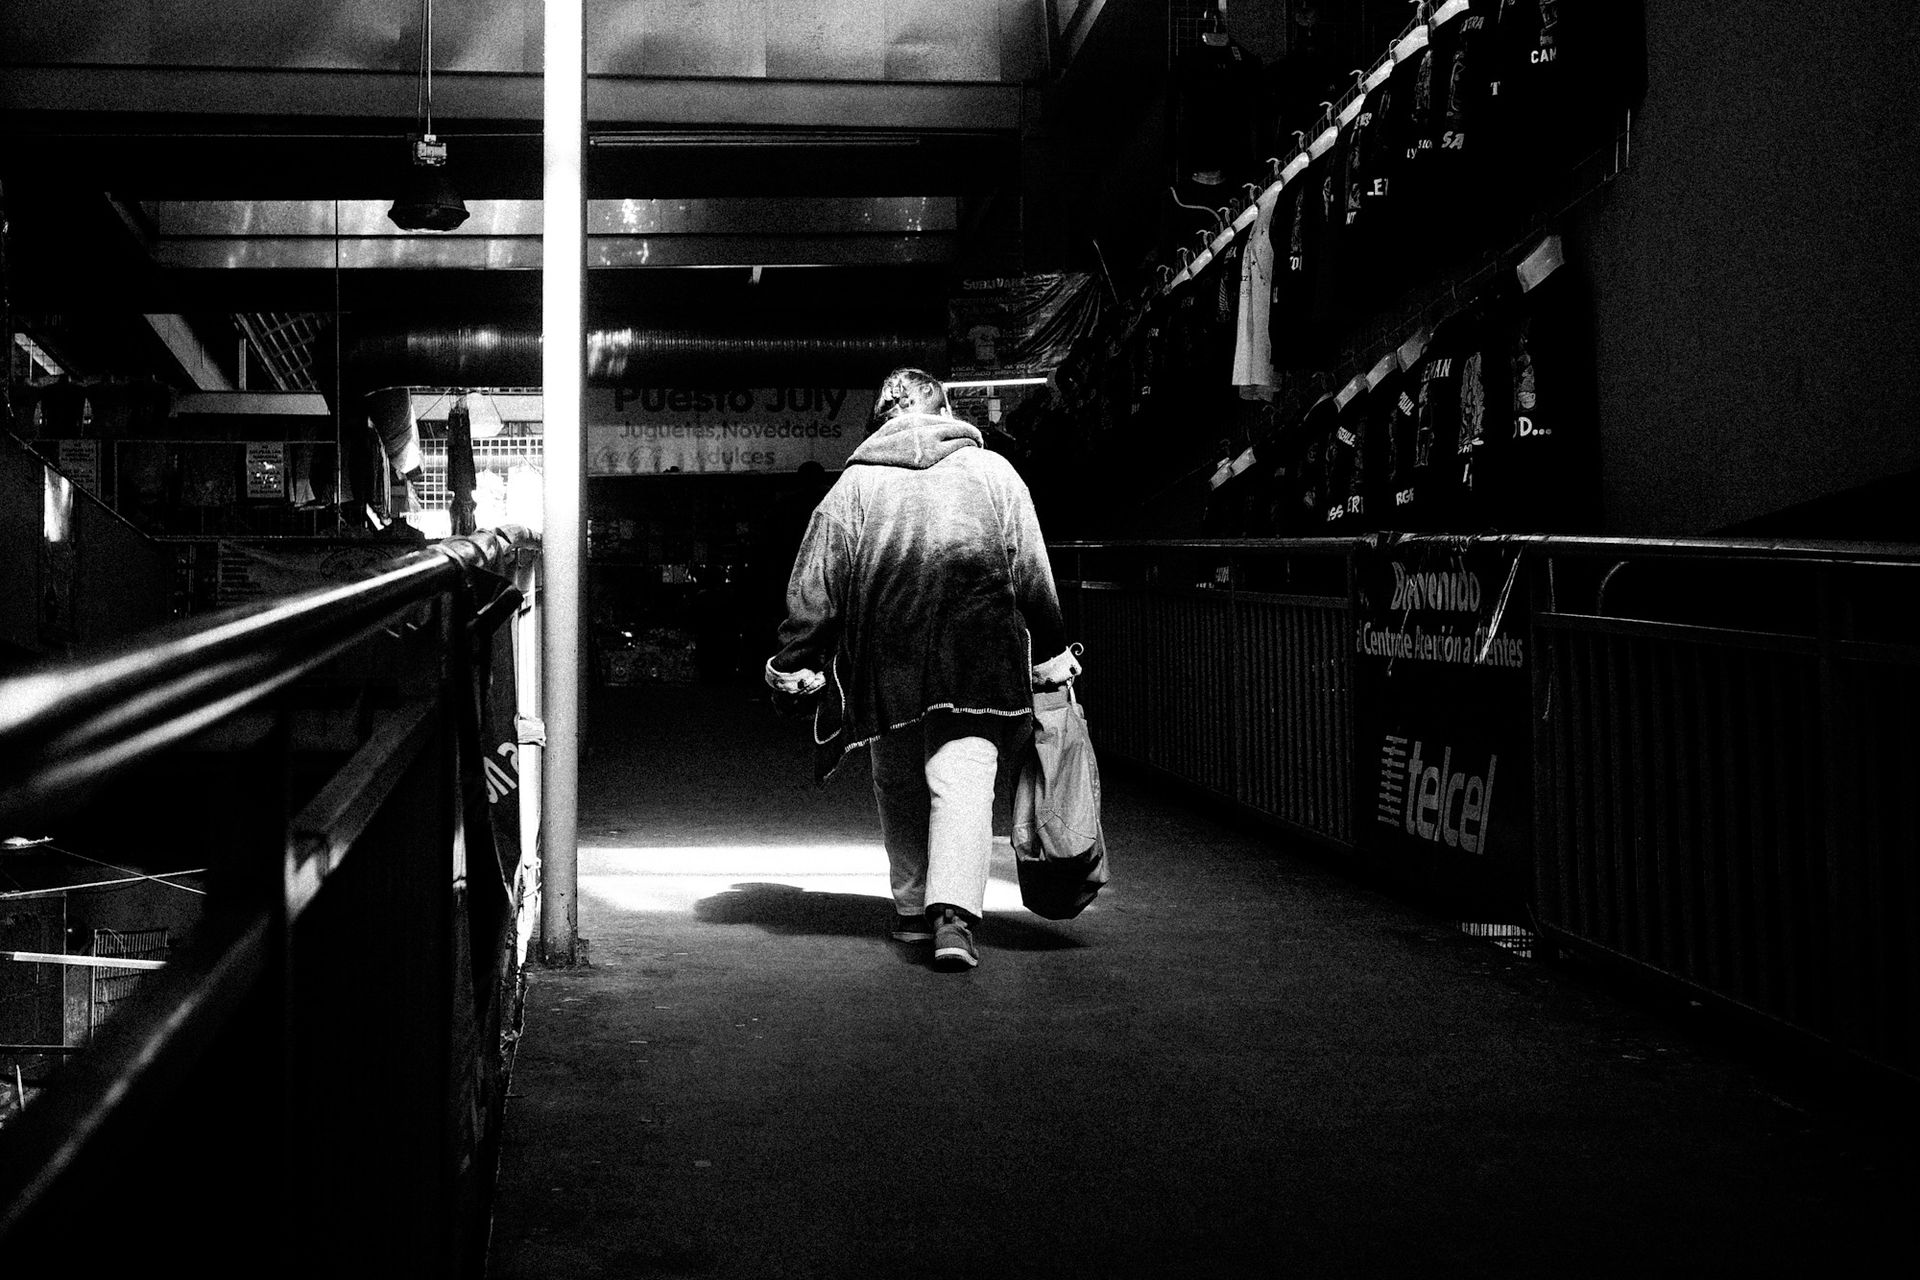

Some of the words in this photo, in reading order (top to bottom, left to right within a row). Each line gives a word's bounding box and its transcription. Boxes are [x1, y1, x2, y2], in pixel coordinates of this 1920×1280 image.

[614, 386, 754, 413] Puesto
[764, 386, 848, 421] July
[707, 446, 776, 466] dulces
[1462, 636, 1472, 664] a
[1405, 741, 1498, 855] telcel
